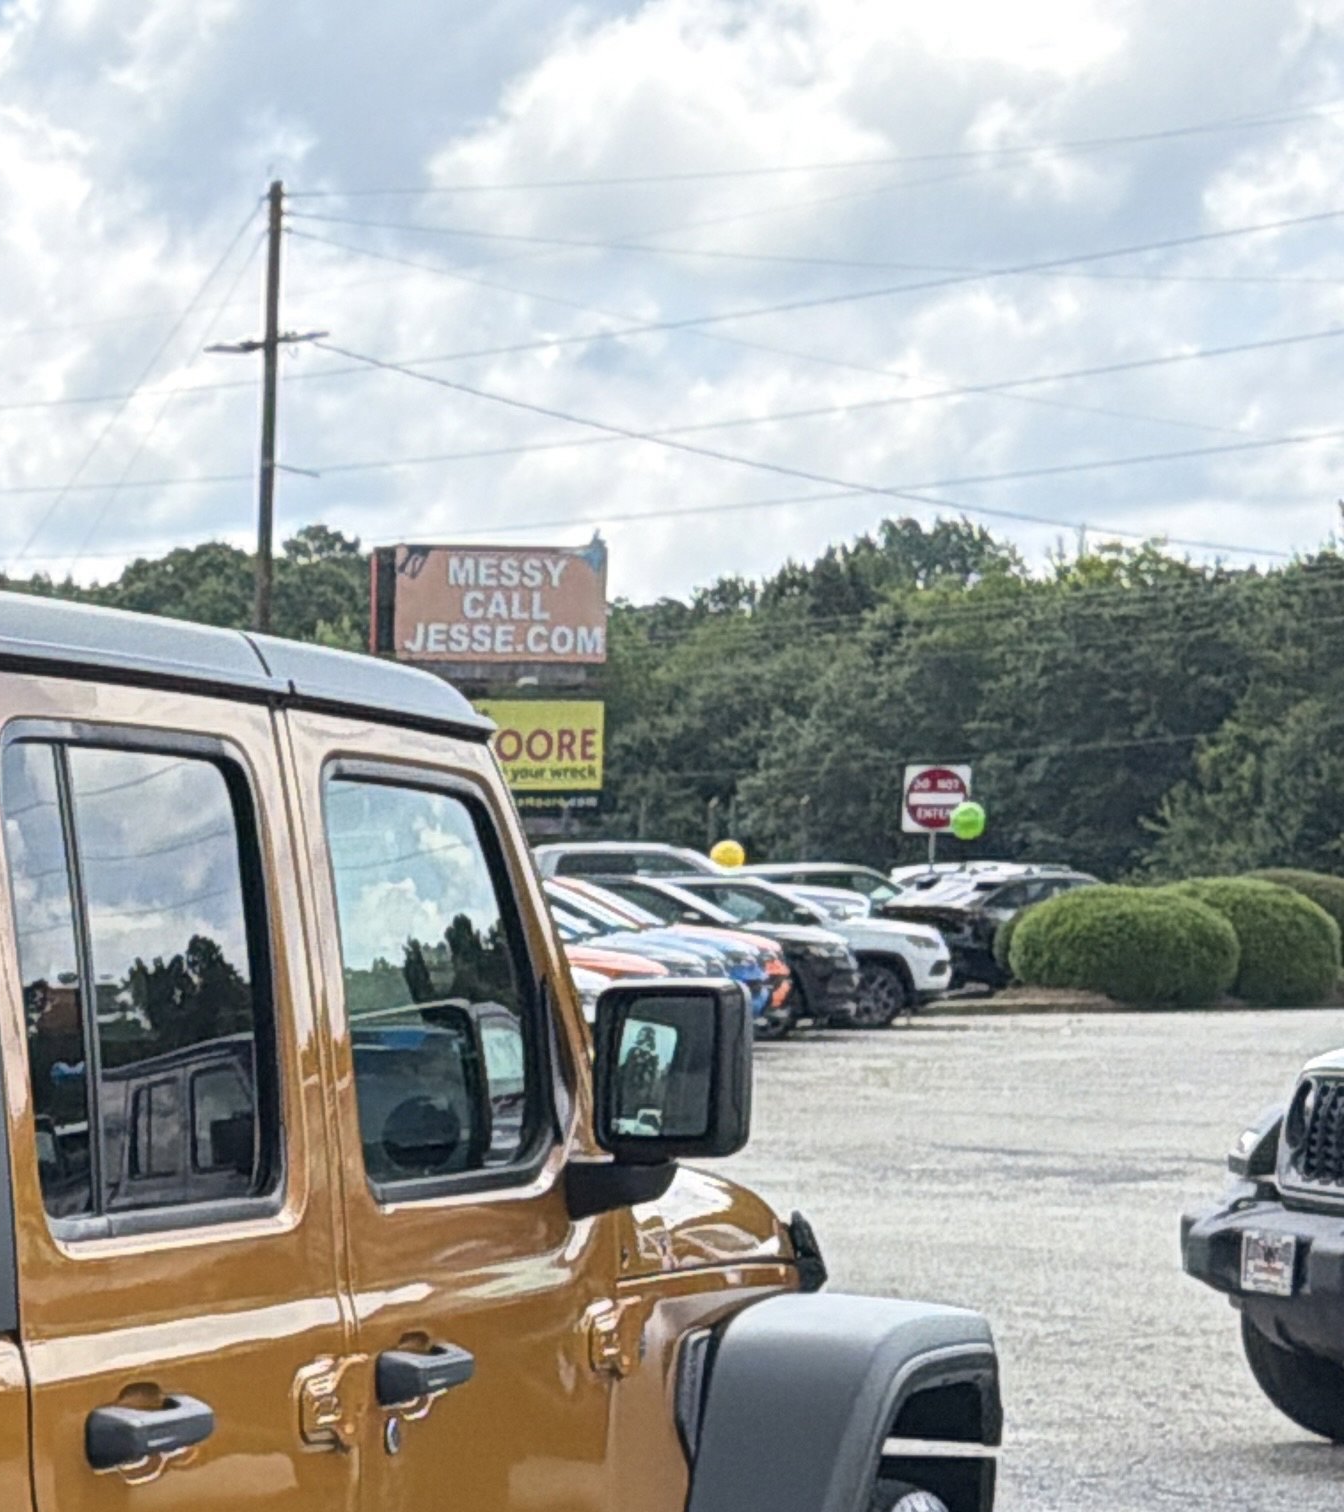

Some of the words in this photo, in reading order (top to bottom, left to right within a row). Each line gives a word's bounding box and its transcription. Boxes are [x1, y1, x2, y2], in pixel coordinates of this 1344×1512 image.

[447, 557, 566, 588] MESSY
[462, 590, 551, 621] CALL
[403, 622, 604, 655] JESSE.COM
[494, 728, 597, 762] OORE
[510, 767, 546, 783] your
[550, 765, 596, 779] wreck
[936, 778, 960, 790] NOT
